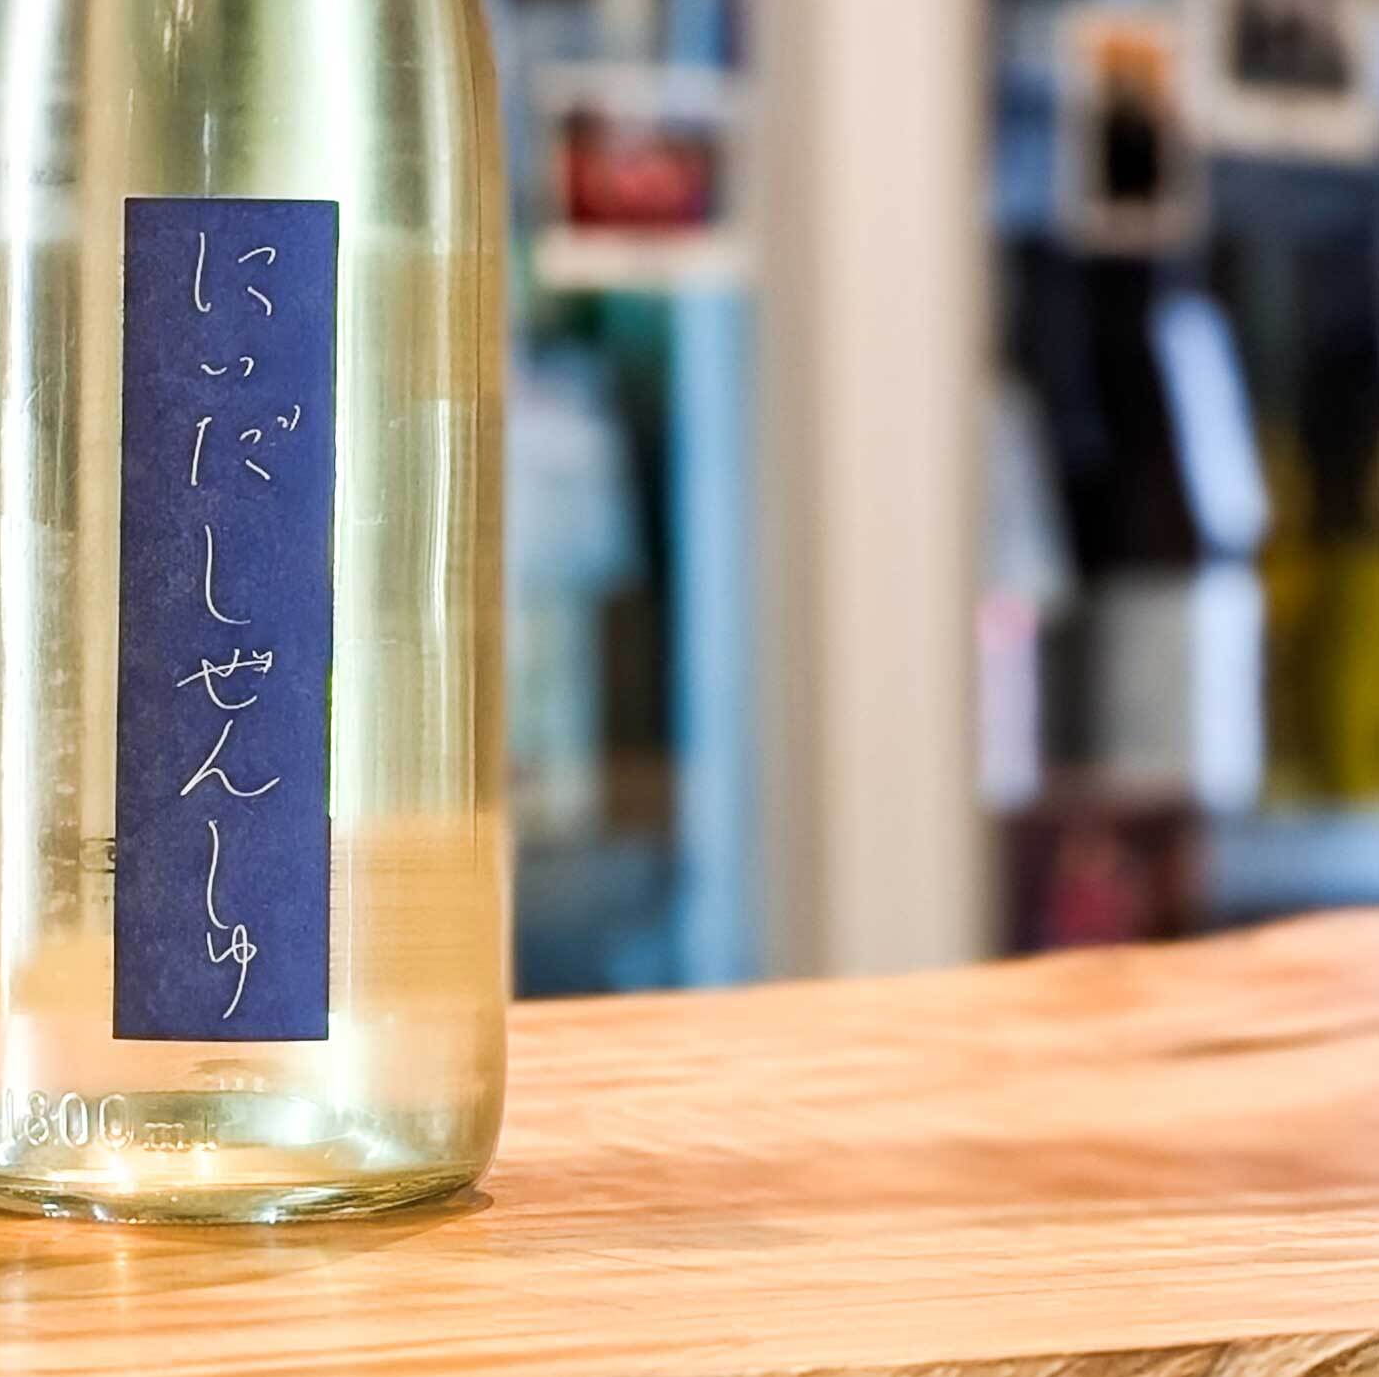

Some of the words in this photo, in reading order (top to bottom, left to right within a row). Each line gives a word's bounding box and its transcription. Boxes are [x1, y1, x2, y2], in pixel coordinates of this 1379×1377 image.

[175, 231, 302, 1020] にいだしぜんしゅ
